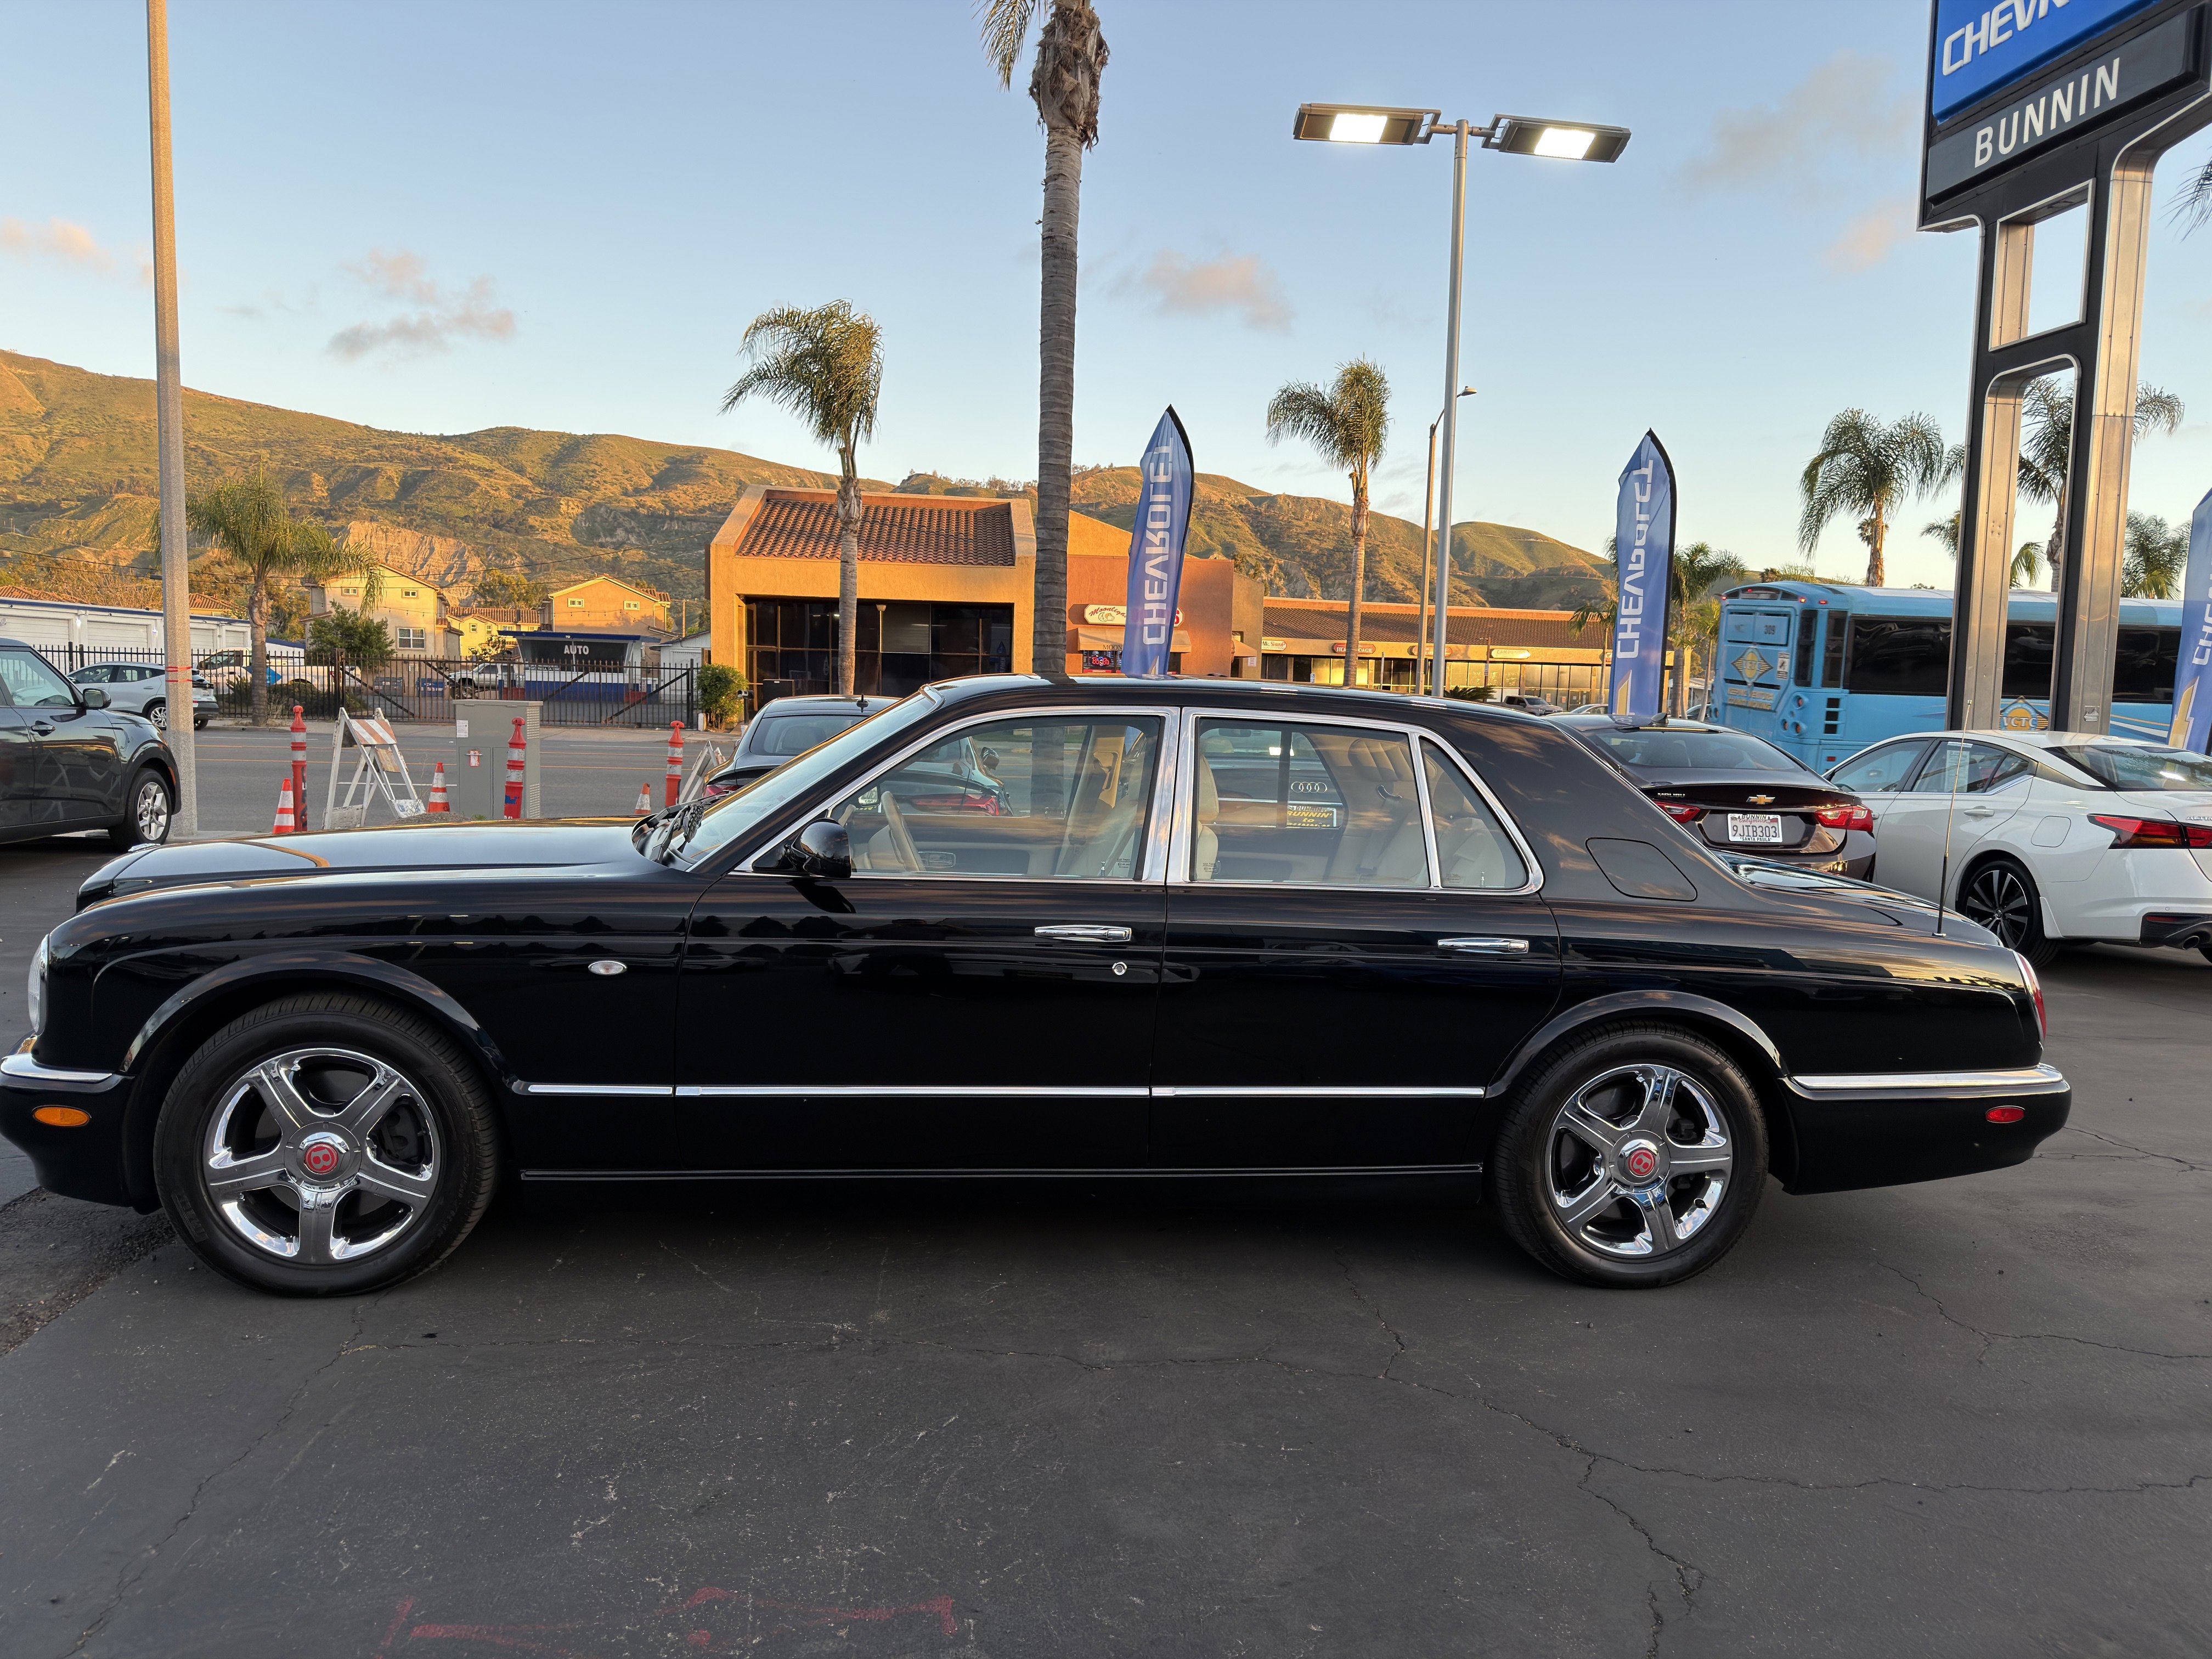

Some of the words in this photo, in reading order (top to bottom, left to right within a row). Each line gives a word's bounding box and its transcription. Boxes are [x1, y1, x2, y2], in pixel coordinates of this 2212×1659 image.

[1975, 57, 2120, 168] BUNNIN
[563, 645, 589, 655] AUTO
[2002, 716, 2038, 727] VCTC
[1732, 825, 1778, 838] 9JIB303
